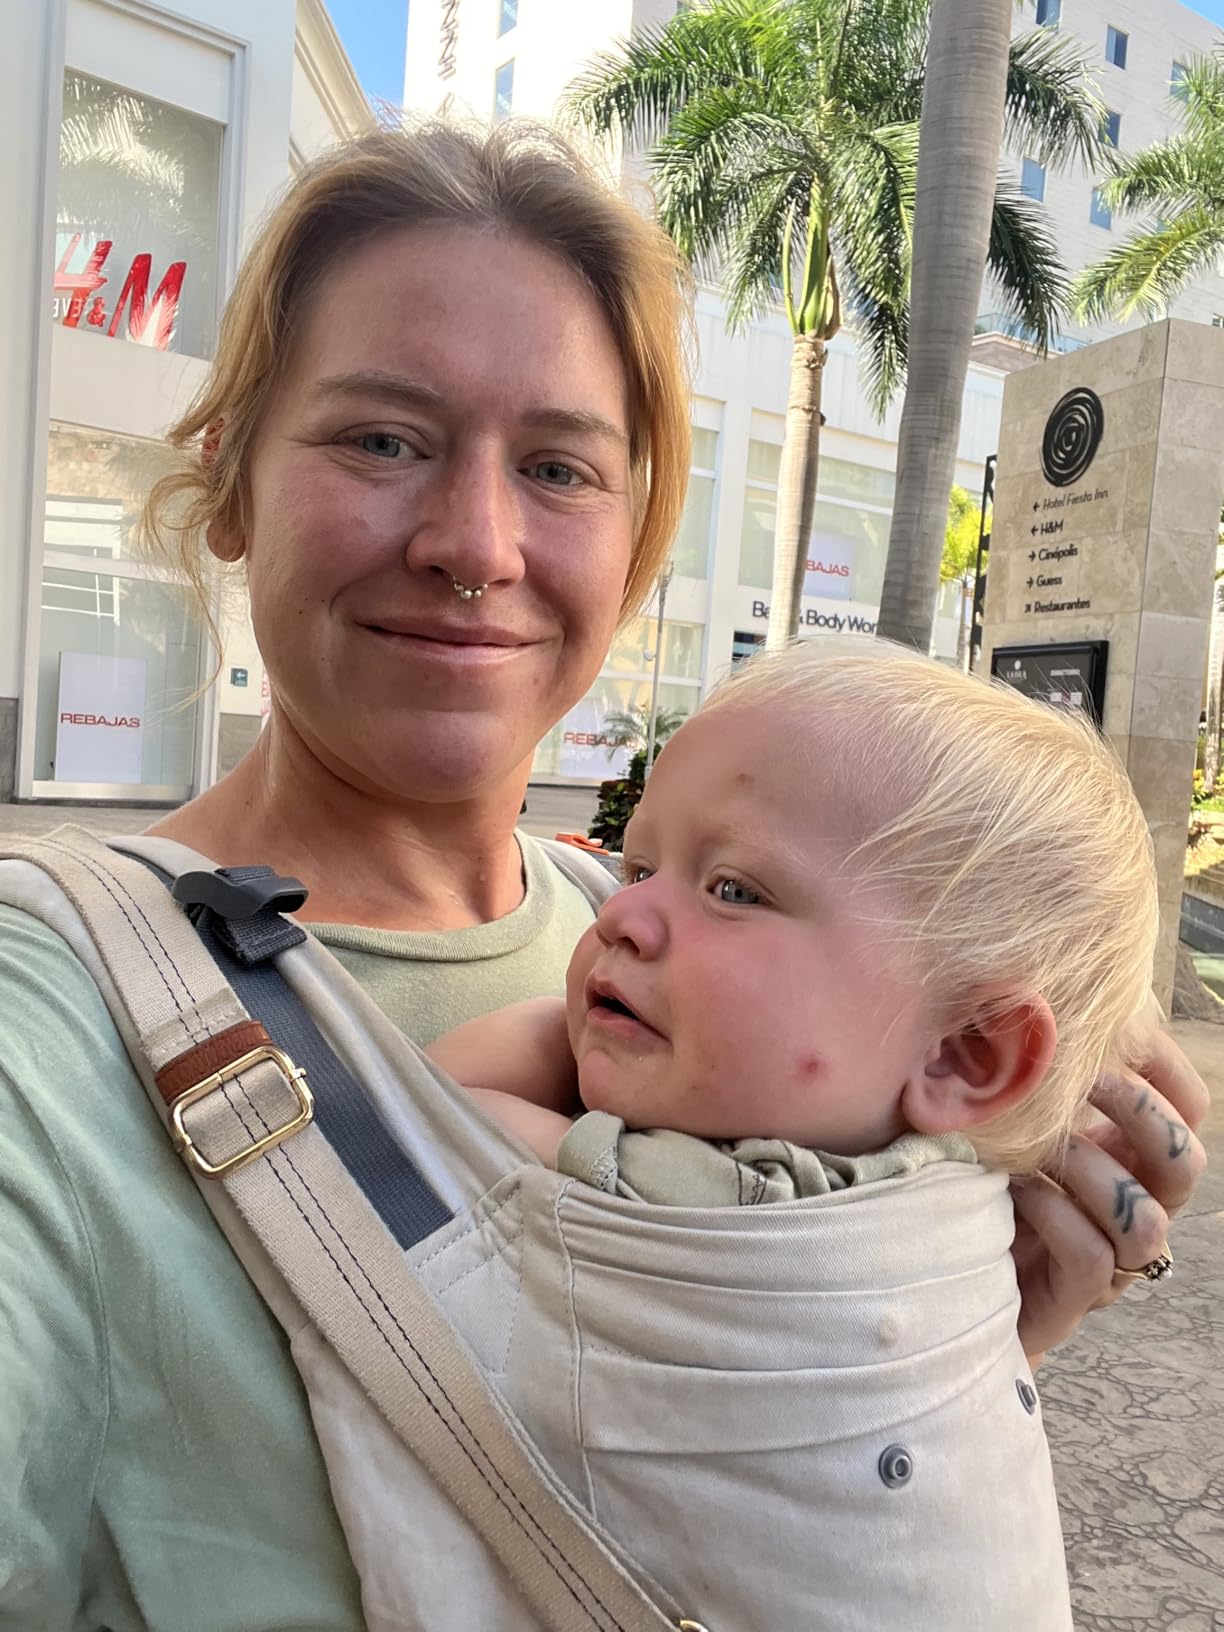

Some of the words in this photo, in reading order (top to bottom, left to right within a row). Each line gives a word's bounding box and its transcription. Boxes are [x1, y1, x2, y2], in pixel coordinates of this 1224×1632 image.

[54, 232, 187, 351] H&M
[1042, 495, 1066, 510] Hotel
[1066, 491, 1093, 506] Fiesta
[1094, 488, 1109, 500] Inn
[1040, 520, 1064, 535] H&M
[1036, 575, 1063, 588] Guess
[1034, 598, 1091, 613] Restaurantes
[806, 609, 846, 633] Body
[60, 713, 140, 729] REBAJAS
